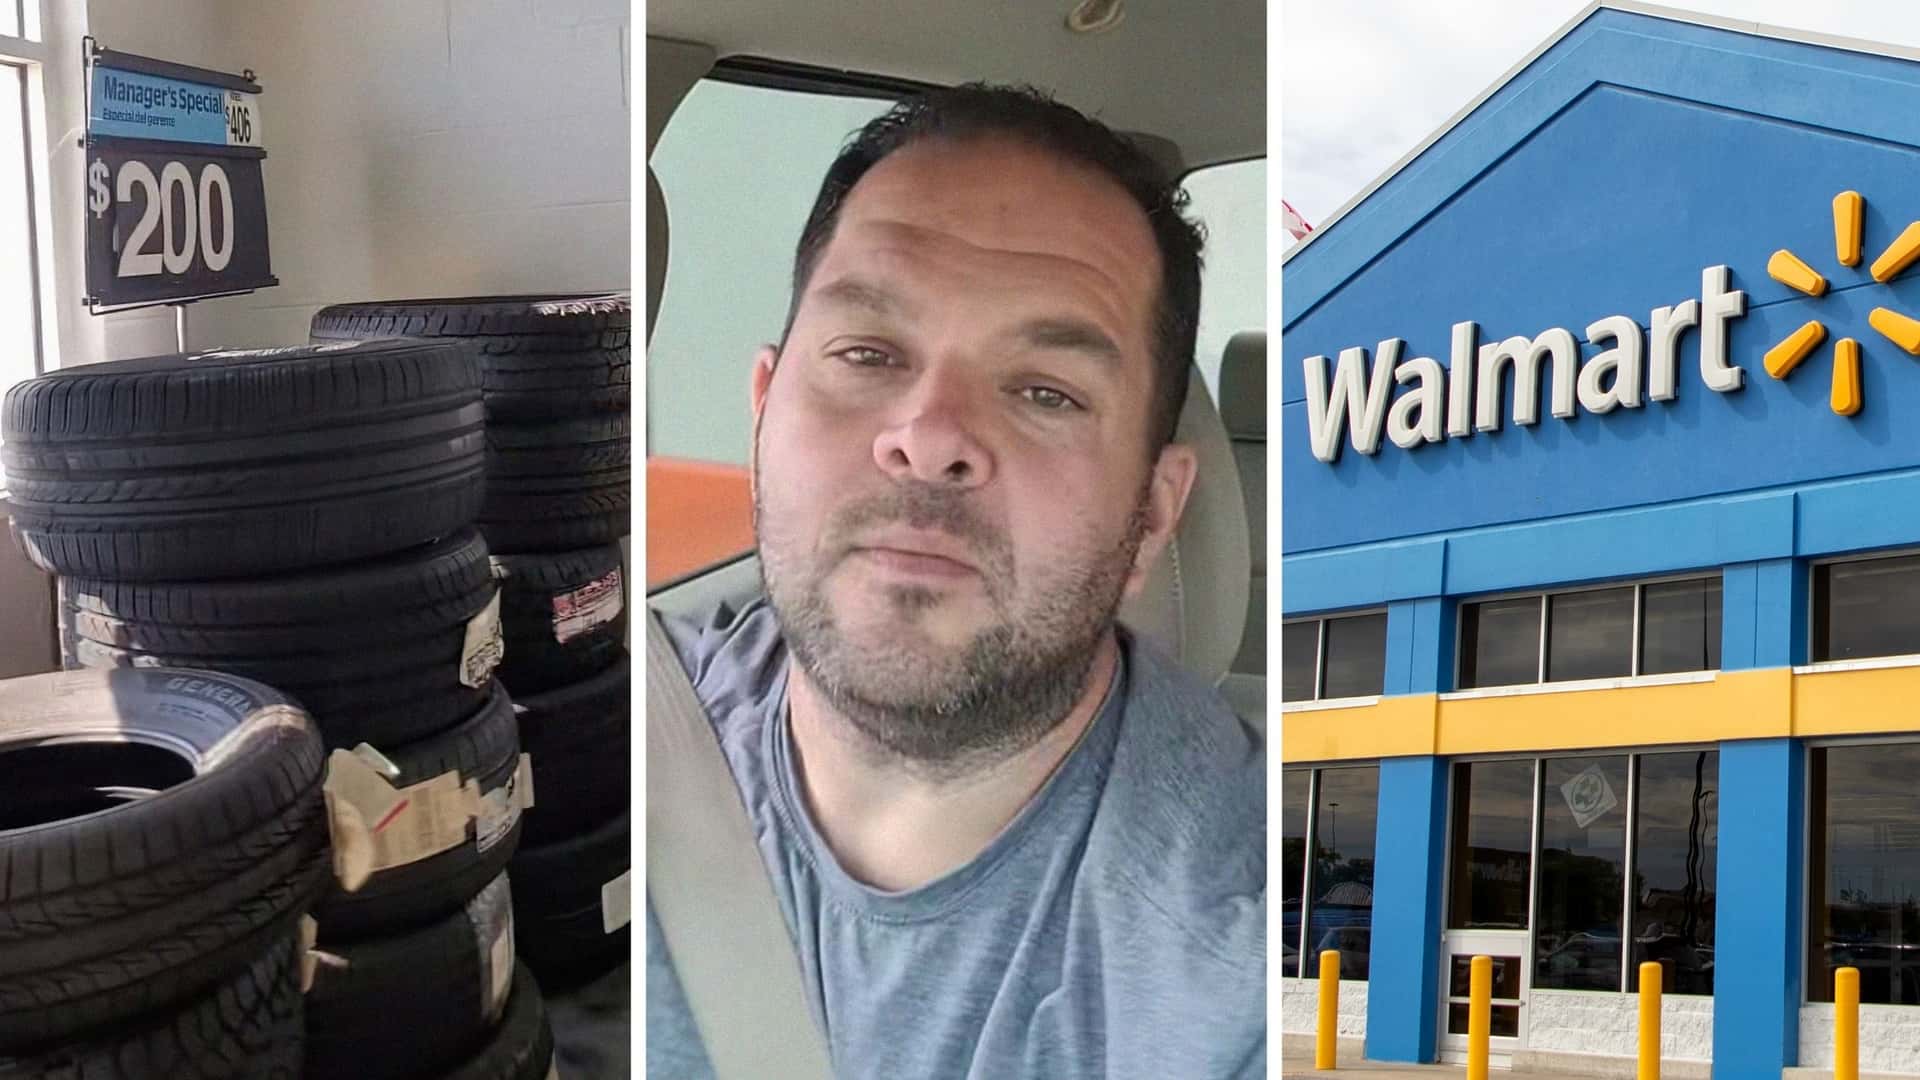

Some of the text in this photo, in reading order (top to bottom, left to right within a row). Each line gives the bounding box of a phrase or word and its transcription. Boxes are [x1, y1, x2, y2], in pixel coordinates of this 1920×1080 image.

[103, 108, 134, 122] Especial
[104, 76, 223, 115] Manager's Special
[89, 158, 234, 277] $200
[1304, 264, 1745, 463] Walmart
